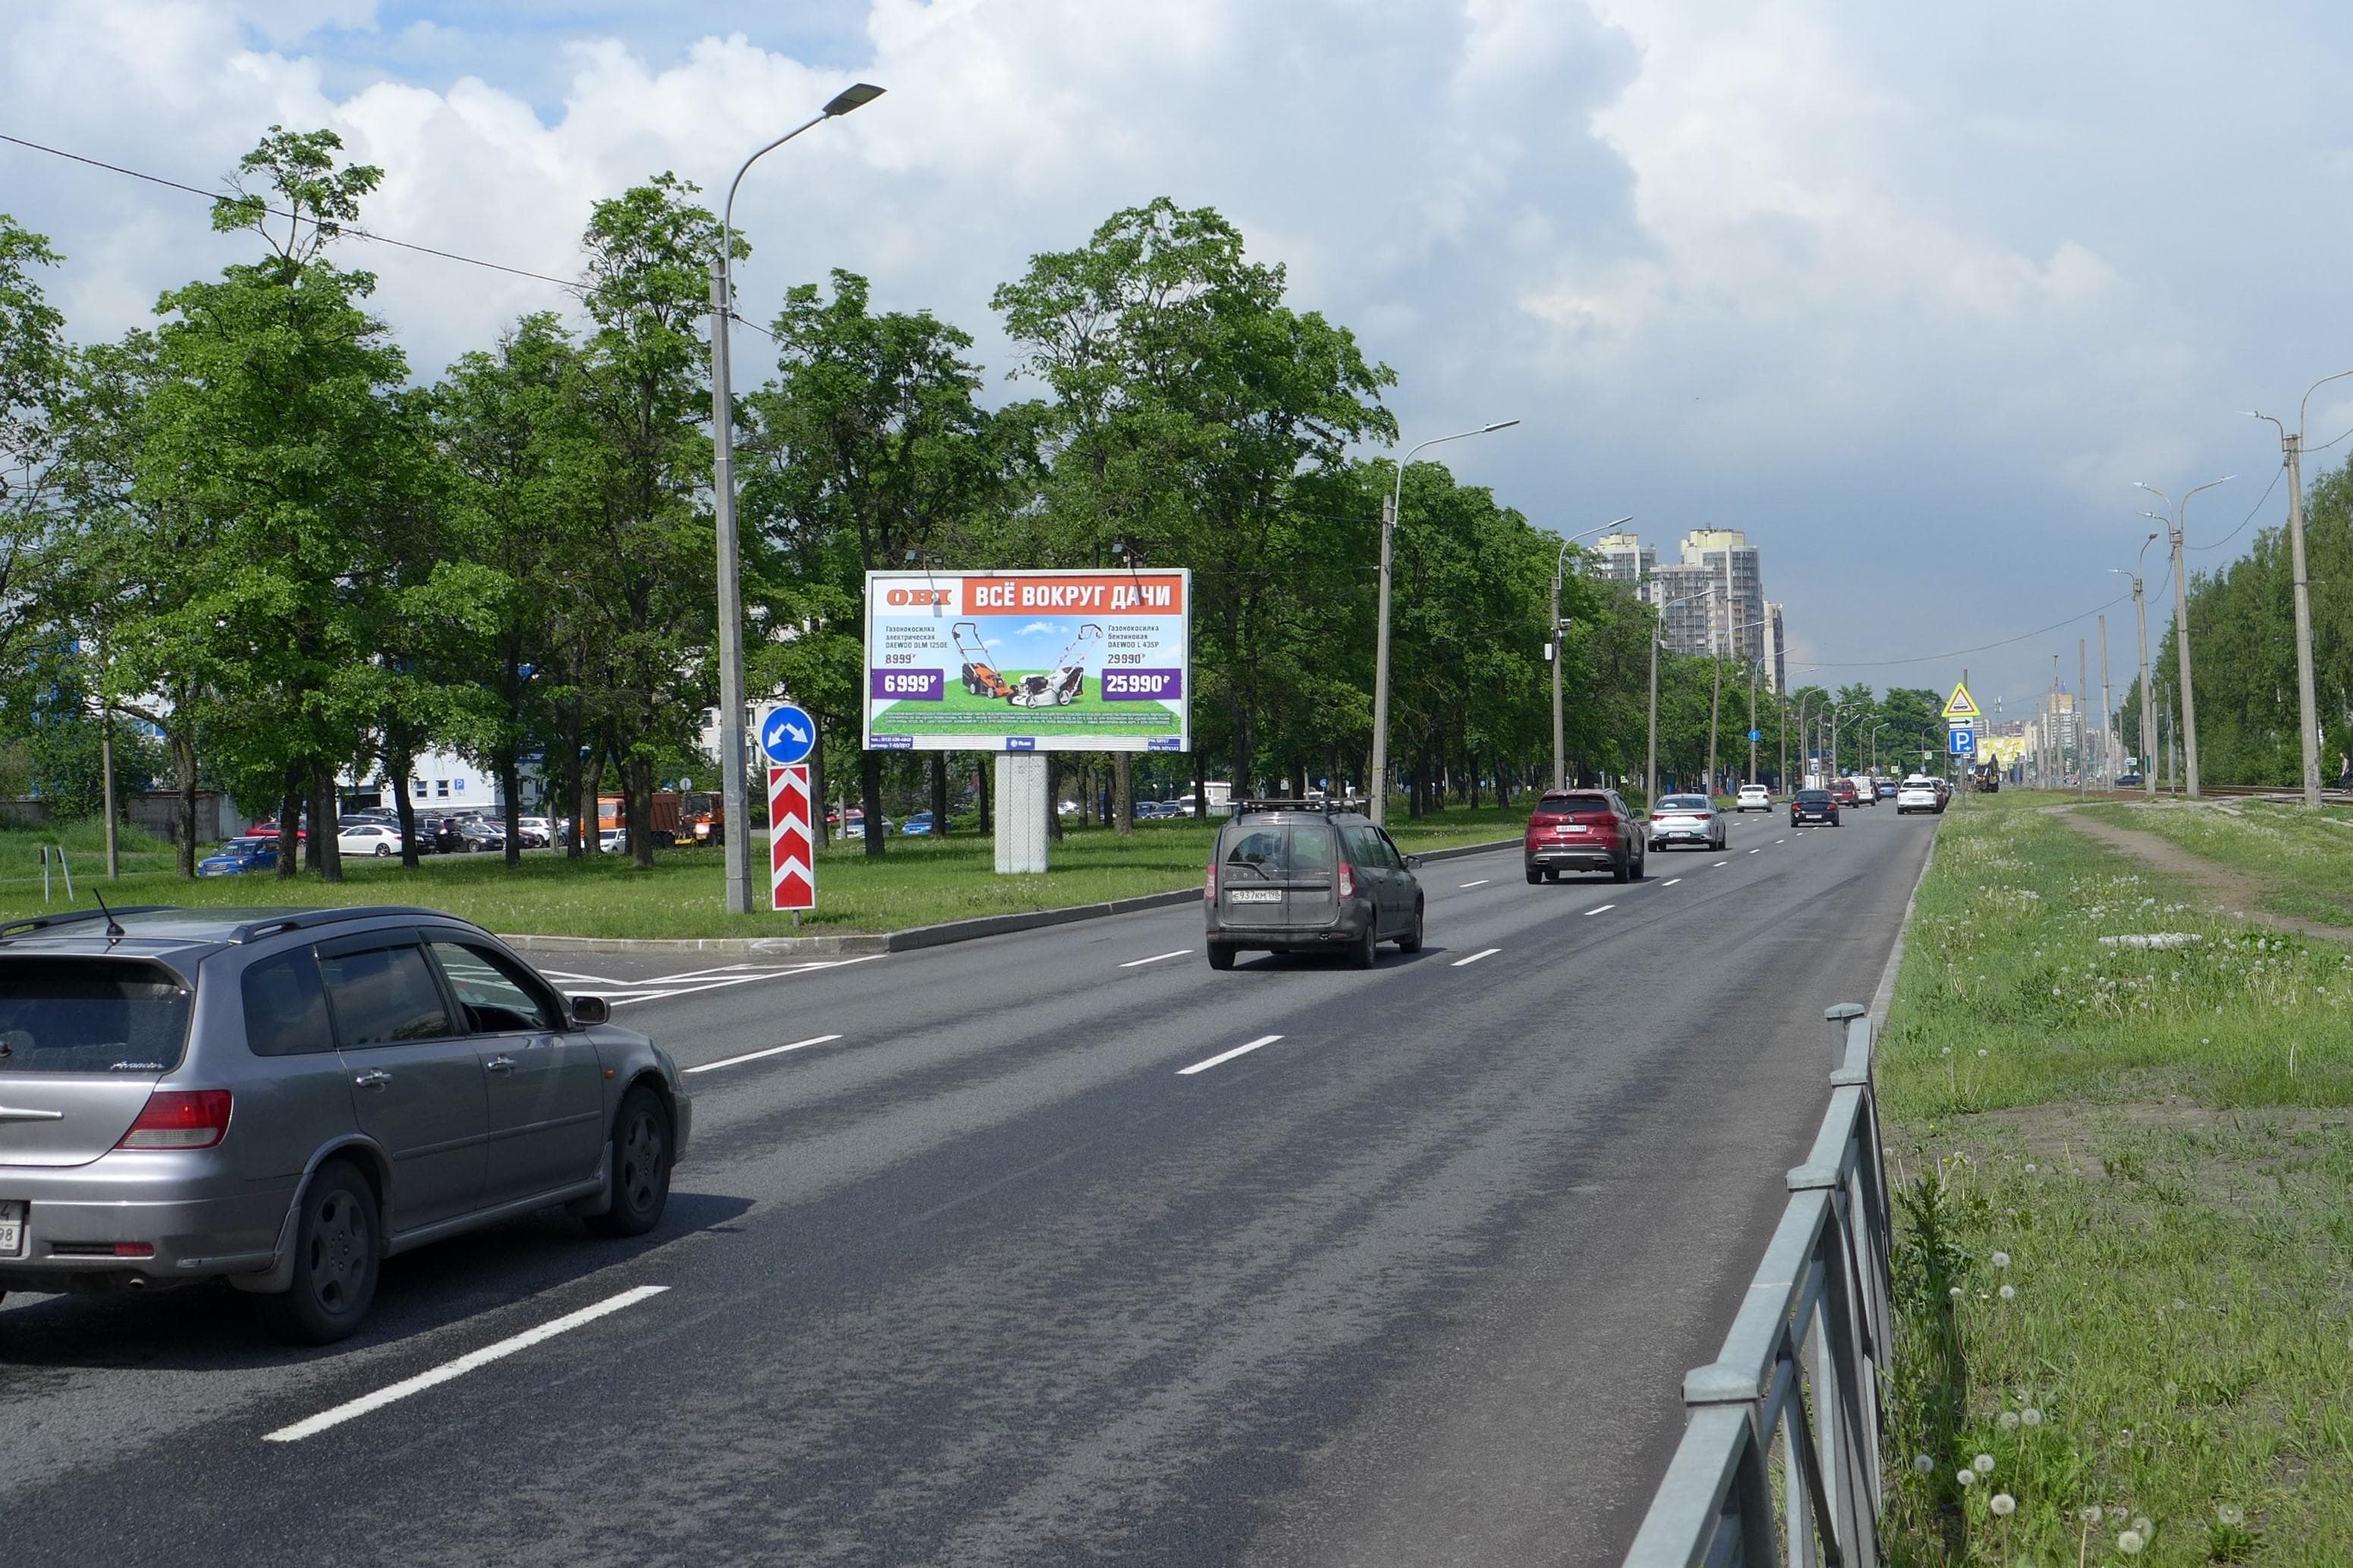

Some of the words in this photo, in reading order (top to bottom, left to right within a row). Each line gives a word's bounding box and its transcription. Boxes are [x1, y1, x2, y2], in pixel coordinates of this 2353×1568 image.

[886, 589, 952, 606] OBI
[976, 582, 1015, 607] ВСЁ
[1022, 585, 1106, 607] ВОКРУГ
[1110, 585, 1171, 610] ДАЧИ
[1955, 732, 1969, 751] P
